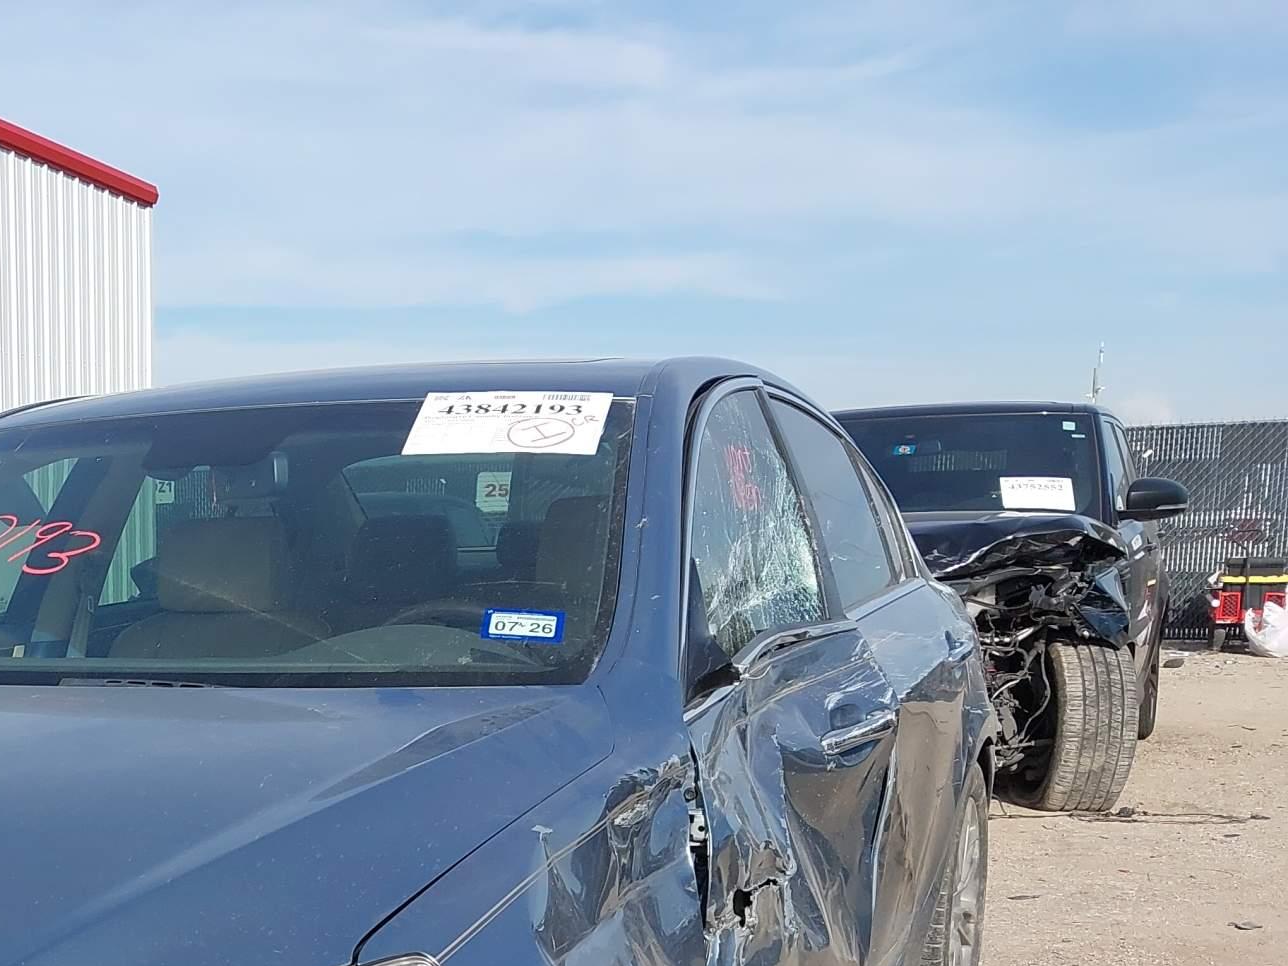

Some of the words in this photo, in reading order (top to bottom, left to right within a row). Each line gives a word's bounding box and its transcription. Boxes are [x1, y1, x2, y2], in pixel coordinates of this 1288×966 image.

[437, 402, 584, 416] 43842193
[484, 483, 509, 498] 25
[494, 620, 519, 632] 07
[528, 622, 553, 634] 26
